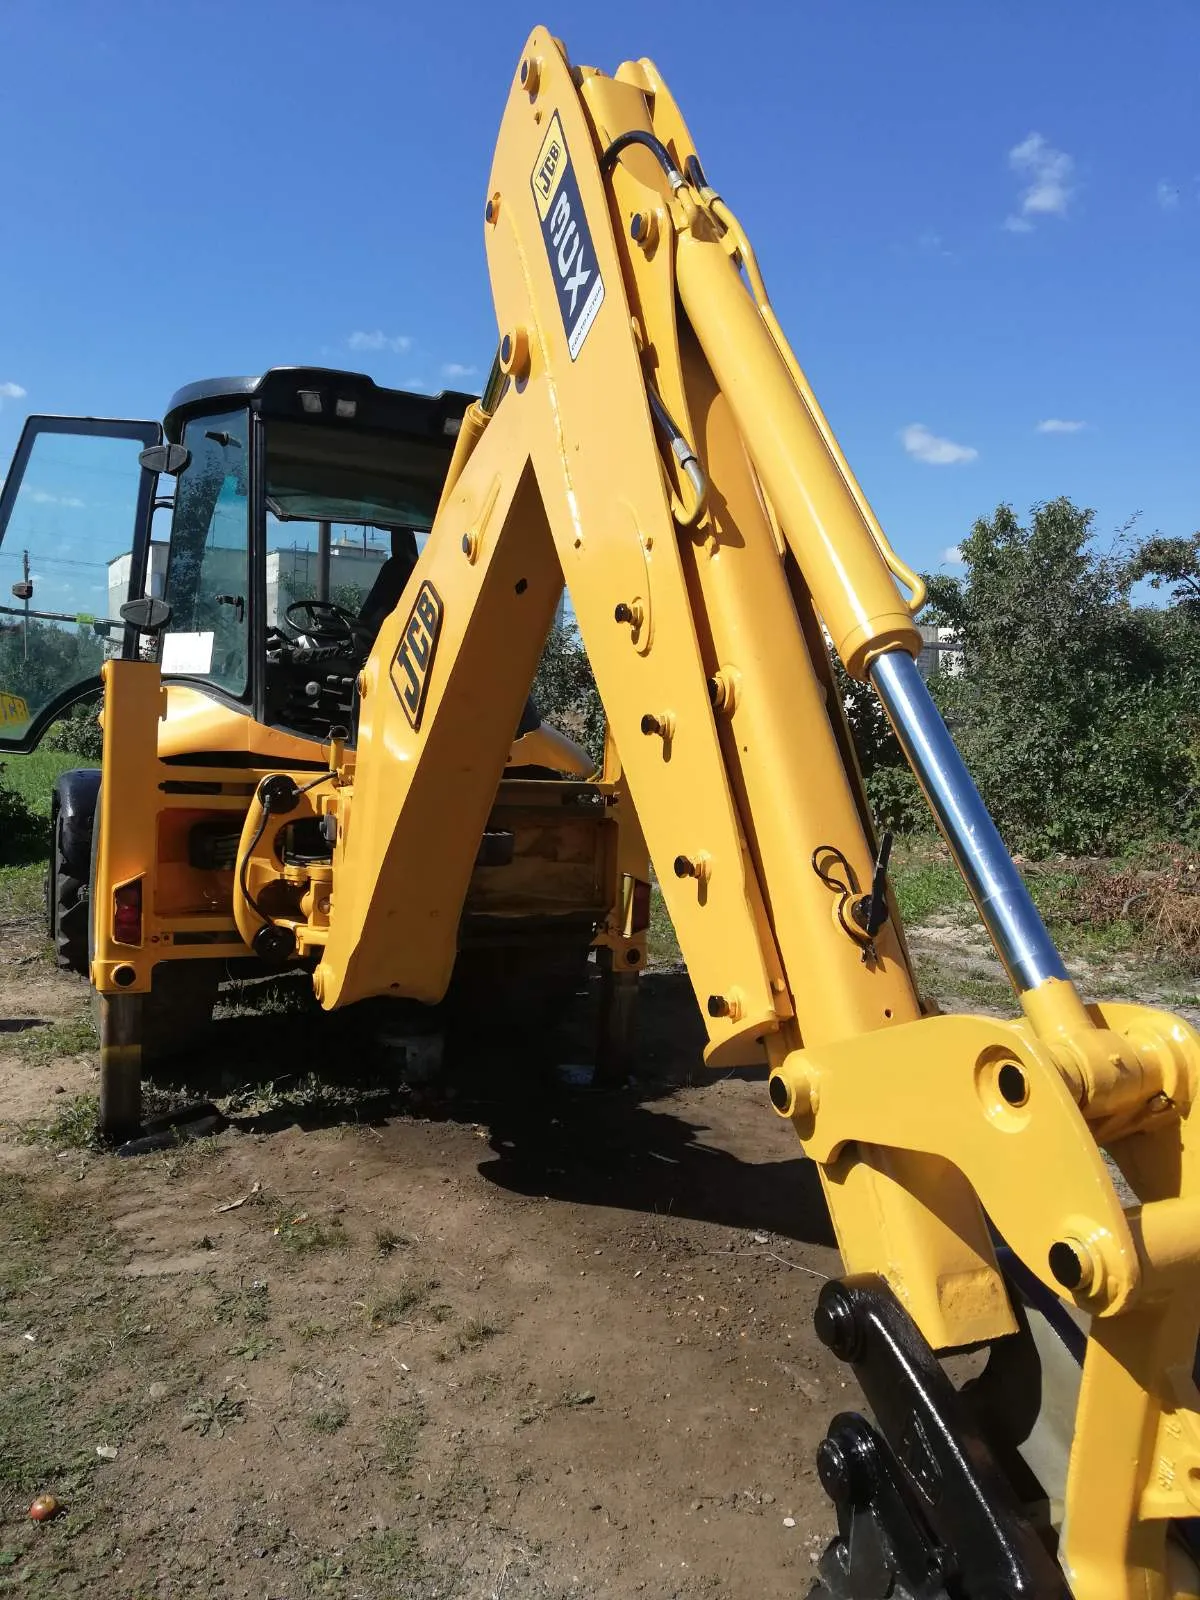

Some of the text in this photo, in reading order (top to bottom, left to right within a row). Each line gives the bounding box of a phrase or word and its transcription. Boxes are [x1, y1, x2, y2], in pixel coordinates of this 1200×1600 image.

[539, 146, 560, 193] JCB
[550, 191, 592, 318] 3CX
[397, 591, 438, 714] JCB
